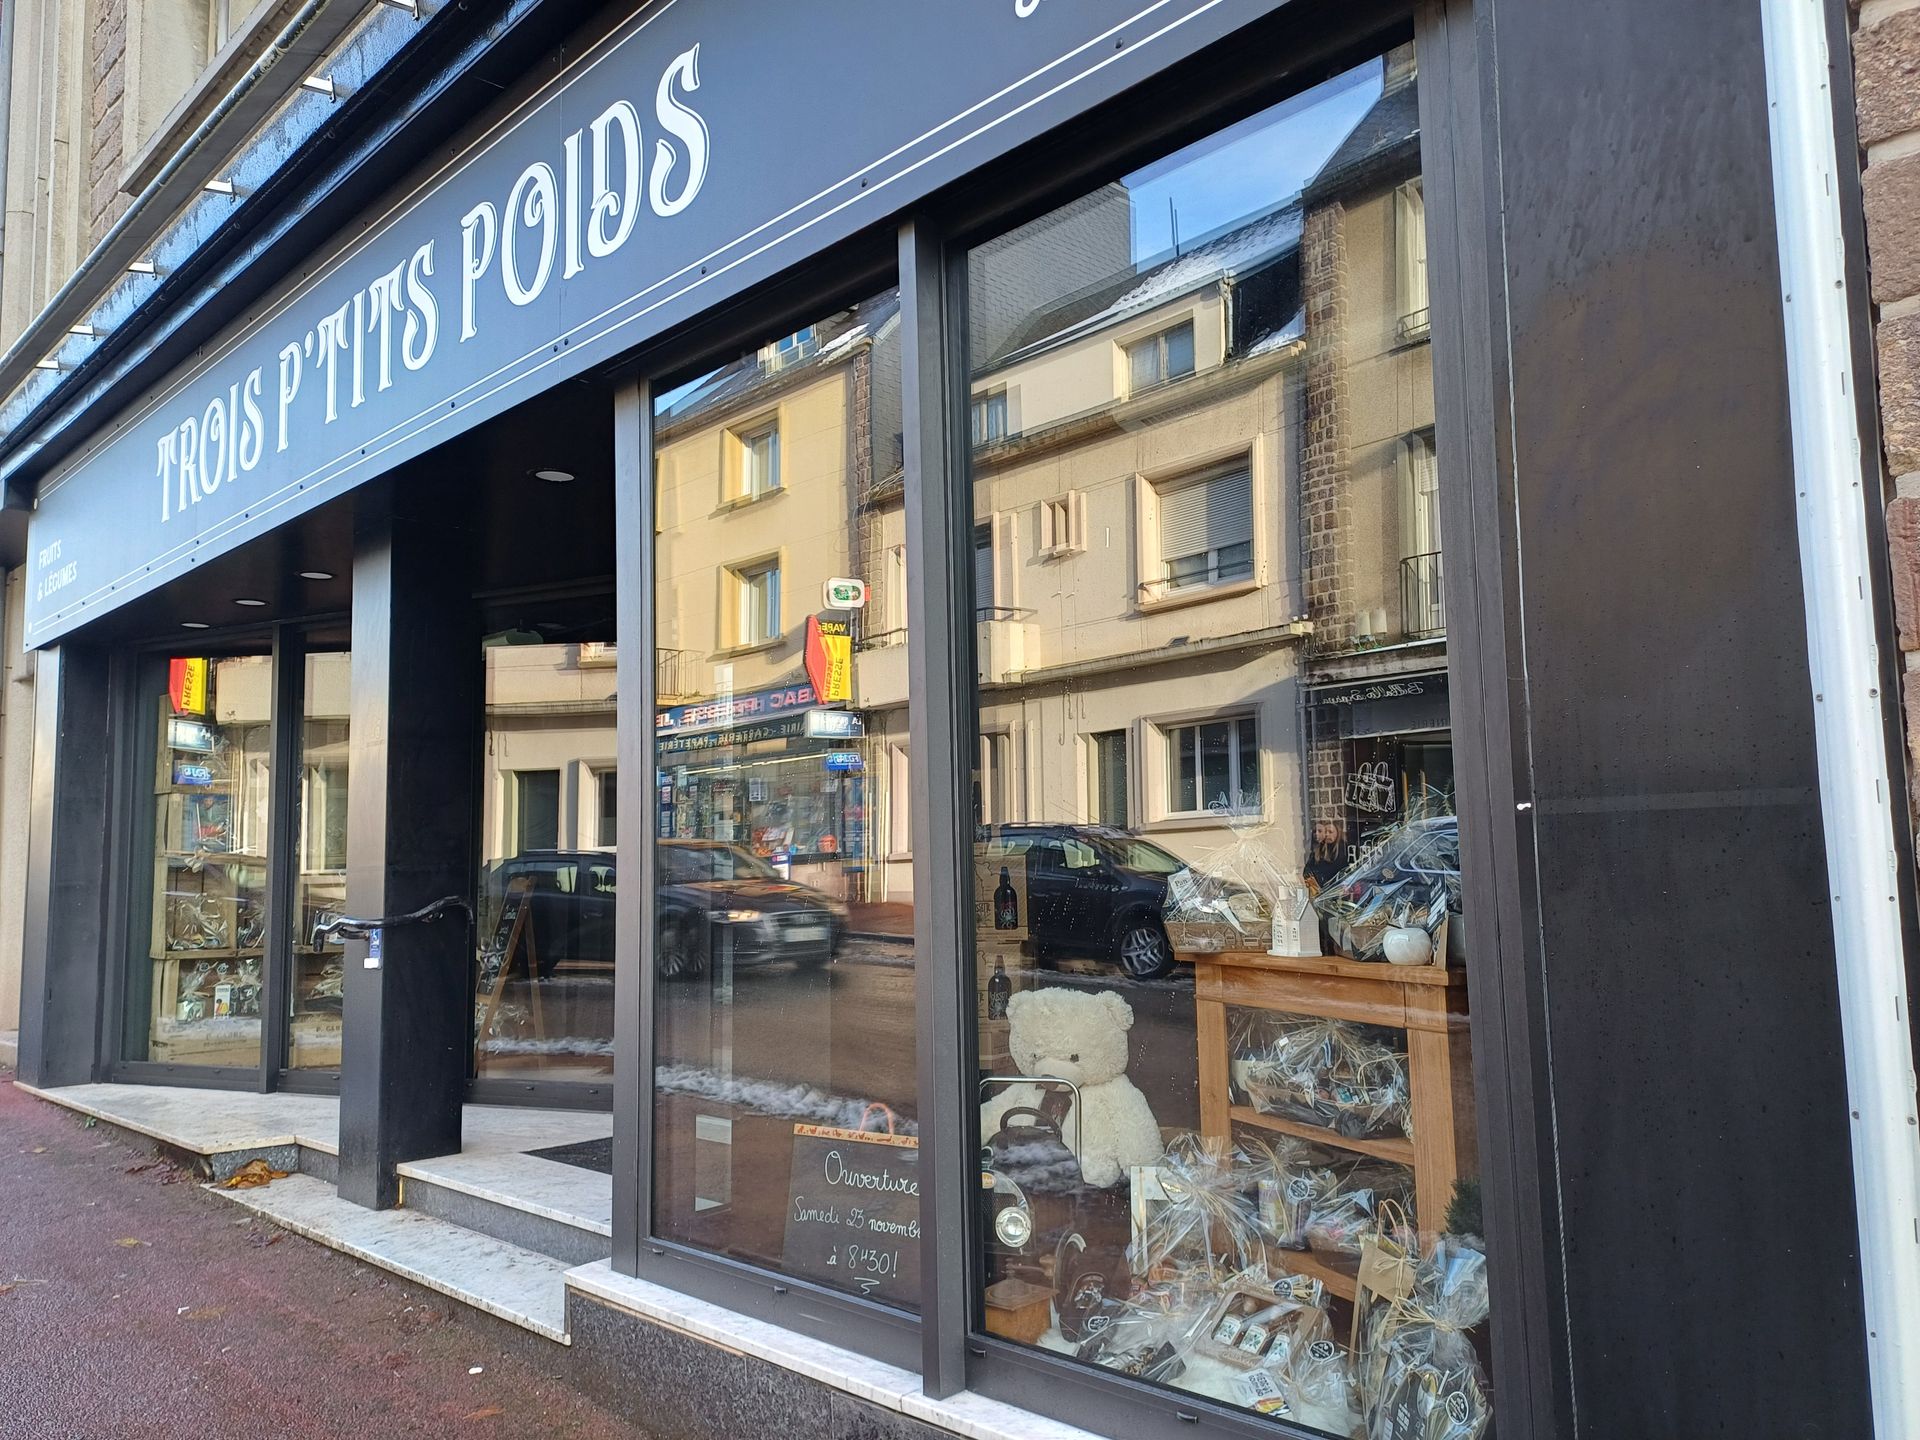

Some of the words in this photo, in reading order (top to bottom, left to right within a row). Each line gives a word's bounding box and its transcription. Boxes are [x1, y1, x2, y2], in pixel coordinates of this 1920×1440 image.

[156, 366, 264, 523] TROIS
[277, 238, 439, 453] P'TITS
[460, 42, 710, 343] POIDS
[38, 539, 62, 571] FRUITS
[825, 1150, 920, 1196] Ouverture
[794, 1196, 840, 1224] Samedi
[868, 1218, 921, 1239] novemb
